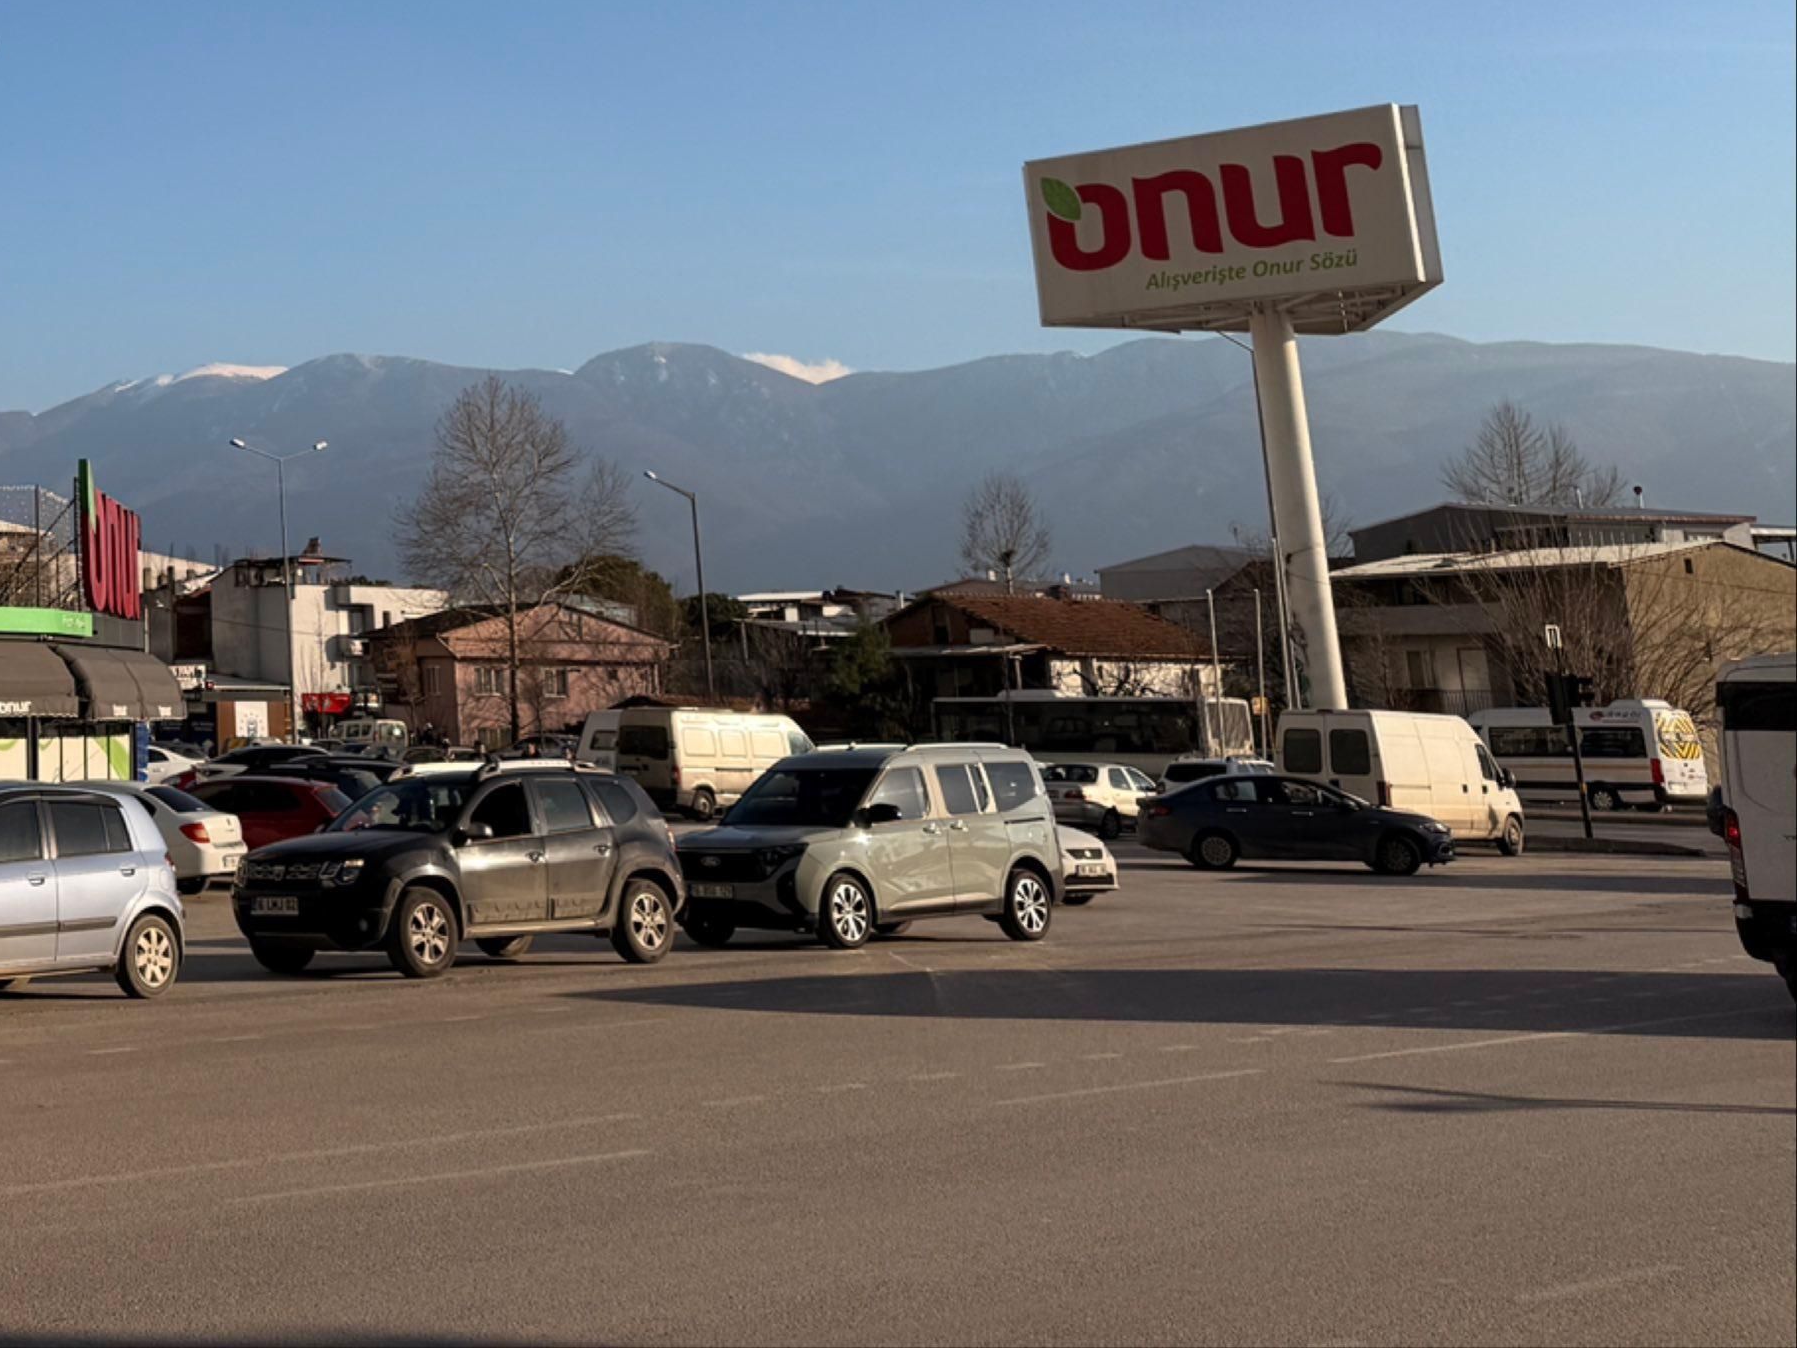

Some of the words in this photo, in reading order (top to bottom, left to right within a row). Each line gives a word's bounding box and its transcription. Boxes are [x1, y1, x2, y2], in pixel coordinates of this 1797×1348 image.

[1041, 142, 1383, 271] onur
[1145, 264, 1247, 292] Alışverişte
[1252, 257, 1304, 278] Onur
[1309, 249, 1359, 272] Sözü
